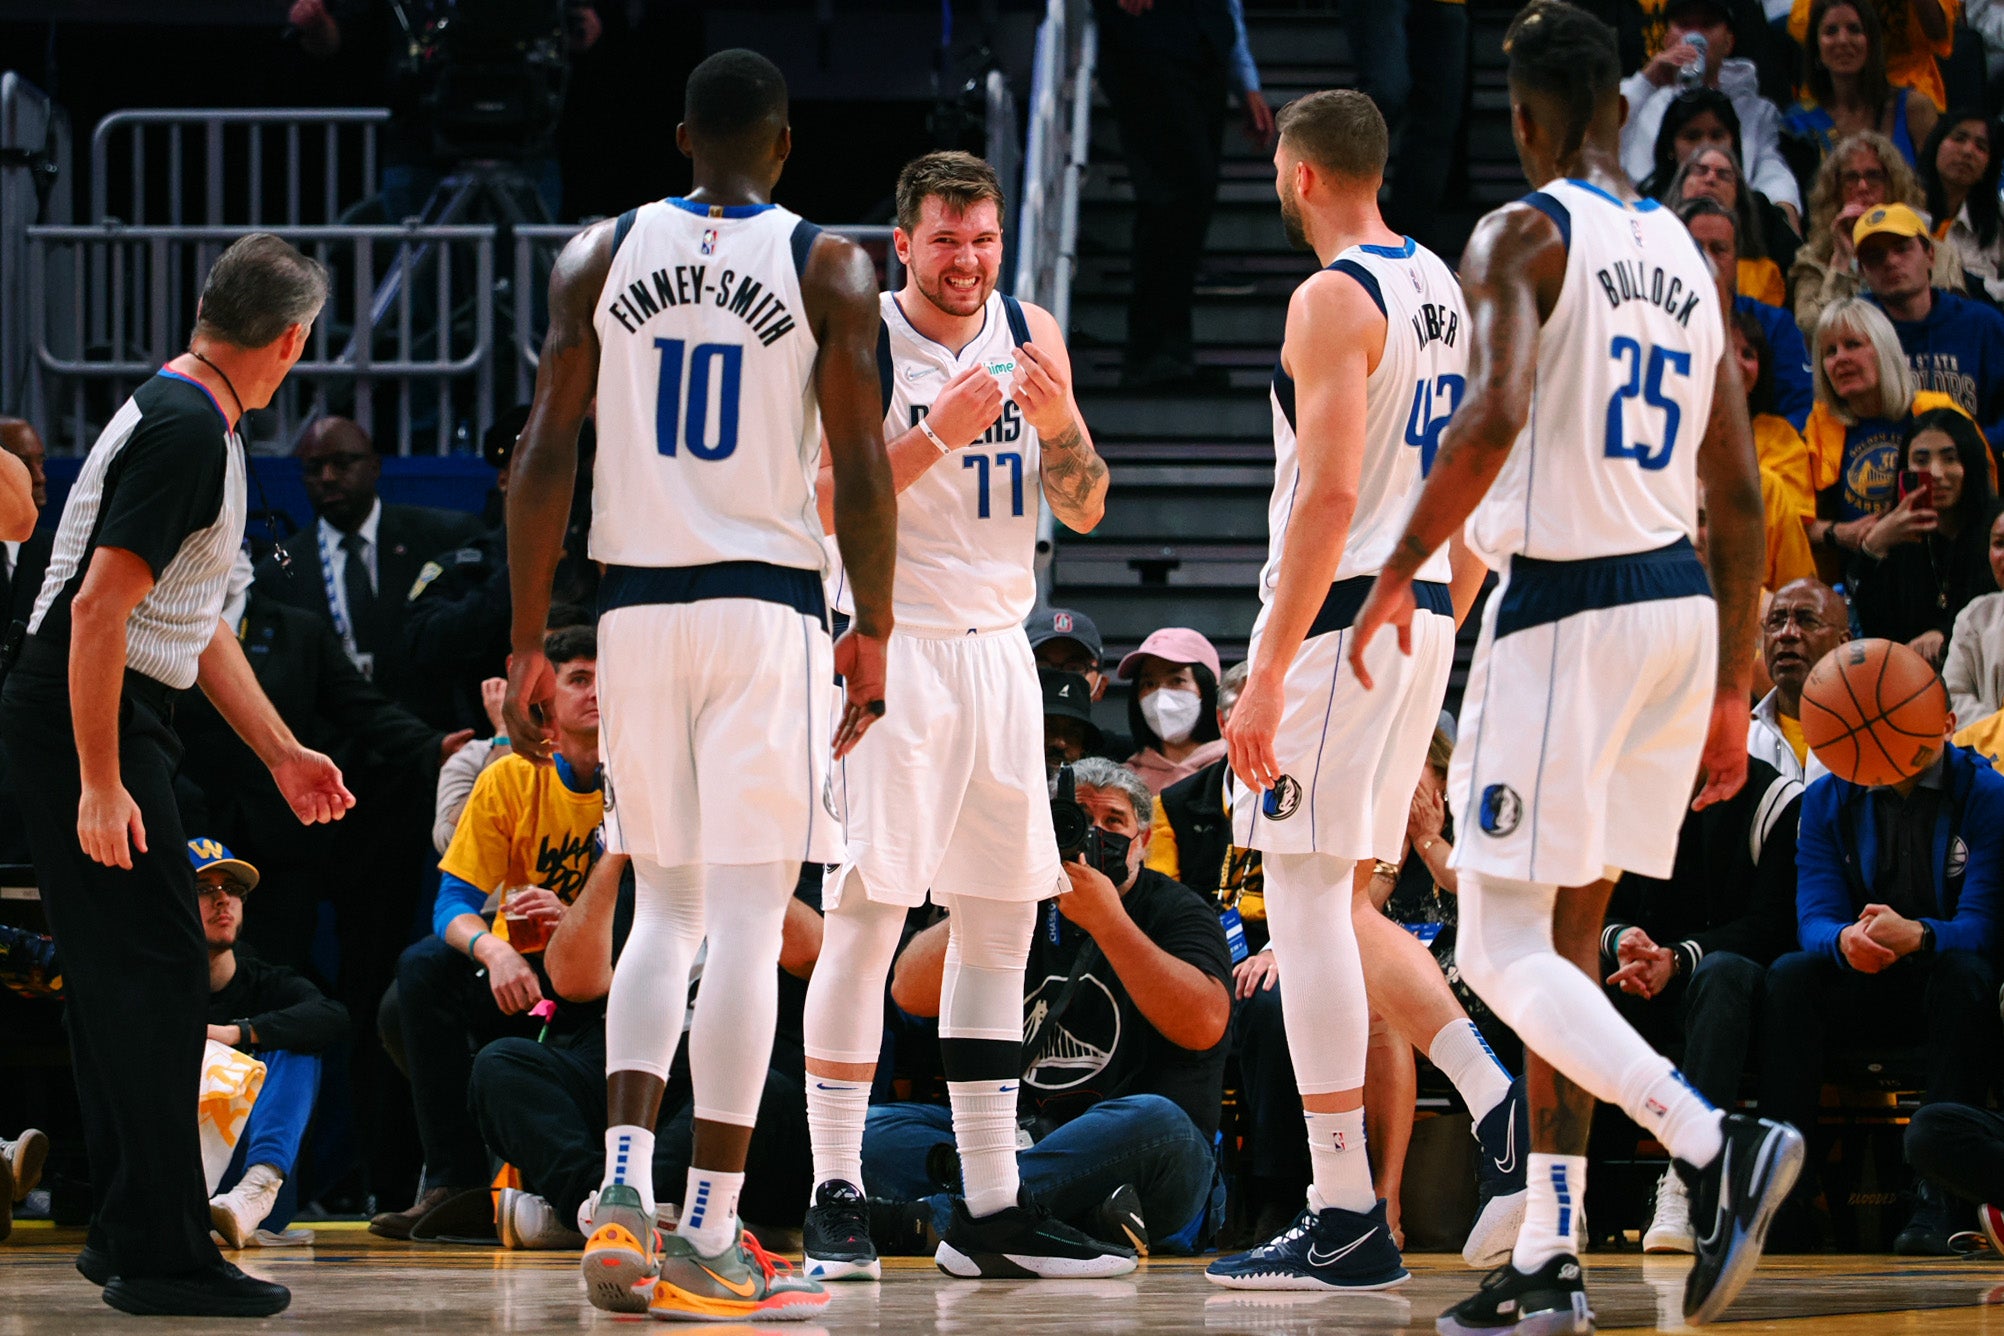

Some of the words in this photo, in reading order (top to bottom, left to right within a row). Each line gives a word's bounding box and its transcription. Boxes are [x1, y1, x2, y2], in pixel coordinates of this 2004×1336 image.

[608, 265, 796, 348] FINNEY-SMITH
[1596, 259, 1700, 329] BULLOCK
[652, 337, 744, 462] 10
[1404, 373, 1467, 481] 42
[1604, 335, 1692, 472] 25
[961, 452, 1025, 520] 77
[187, 839, 224, 860] W
[1048, 911, 1058, 942] CHASE
